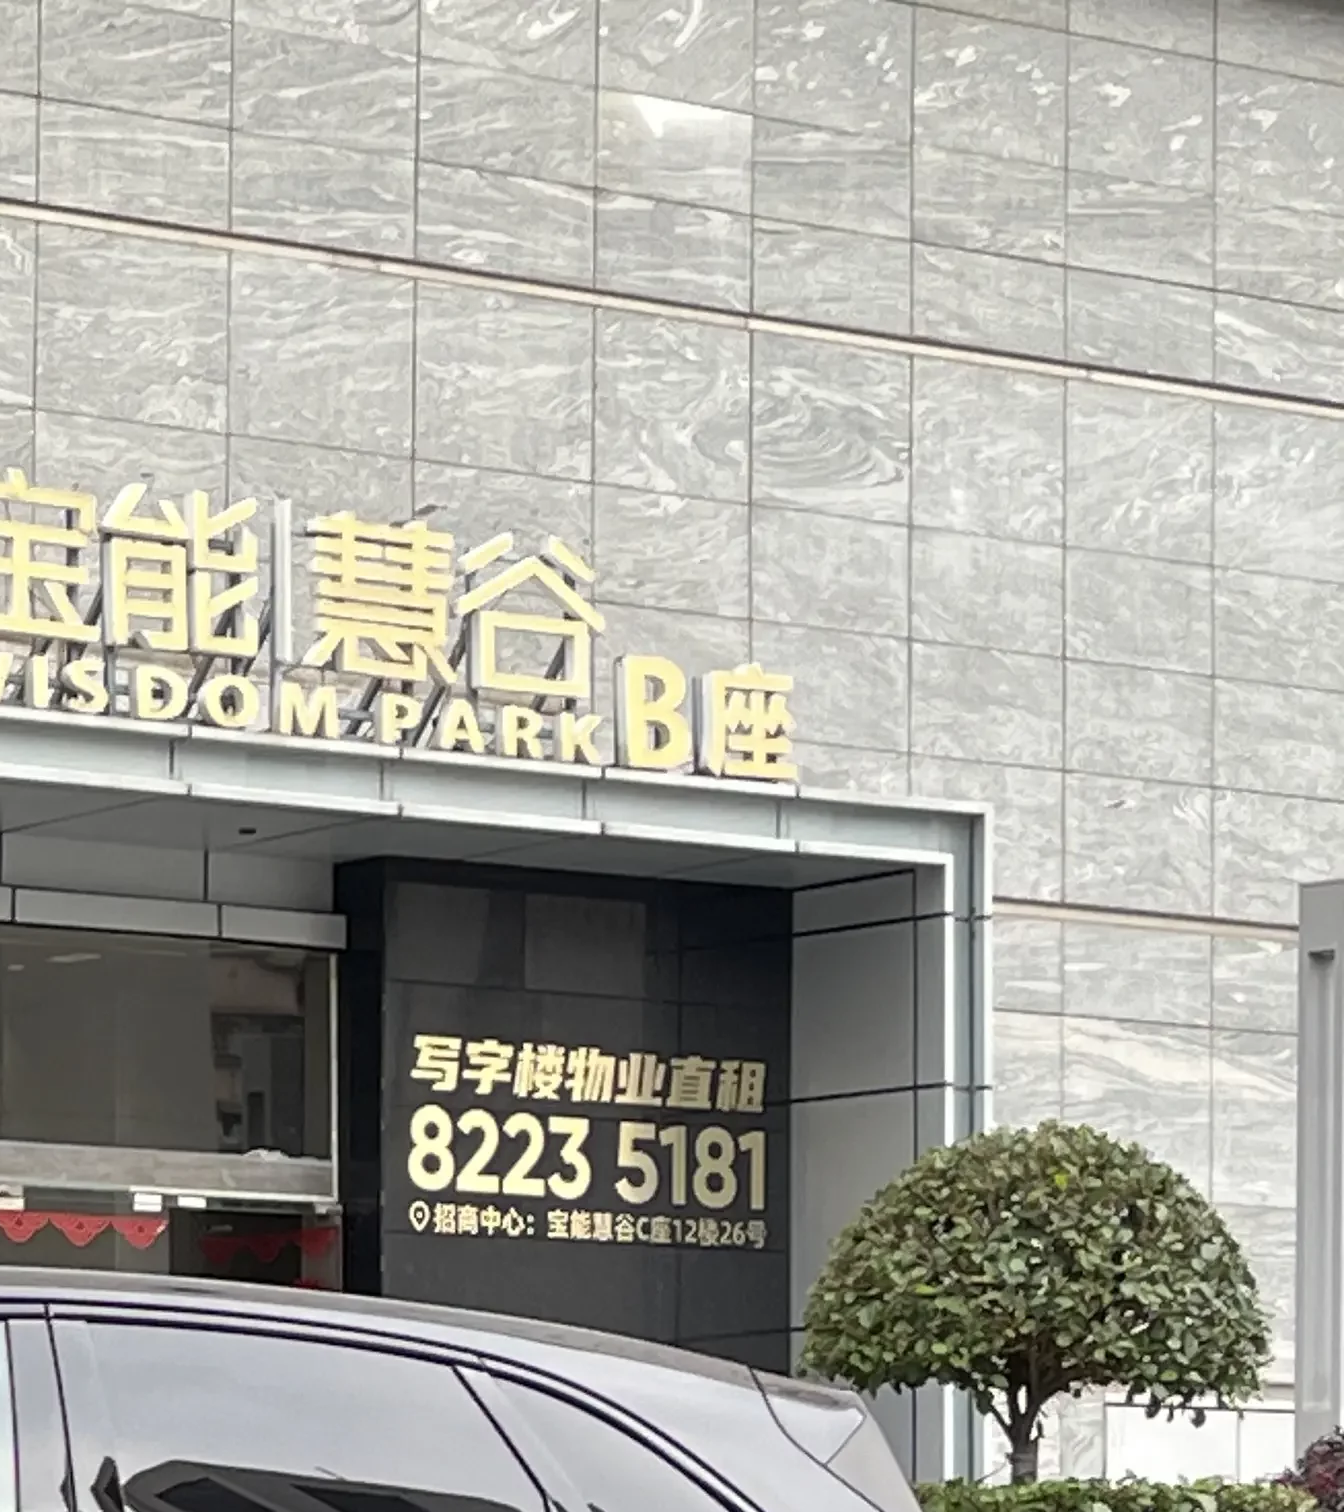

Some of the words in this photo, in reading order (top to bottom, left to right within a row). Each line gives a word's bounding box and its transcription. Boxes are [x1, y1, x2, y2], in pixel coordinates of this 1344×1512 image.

[302, 509, 606, 700] 慧谷
[374, 692, 606, 766] PARK
[614, 655, 798, 783] B座
[409, 1033, 768, 1114] 写字楼物业直租
[407, 1103, 592, 1200] 8223
[614, 1119, 767, 1212] 5181
